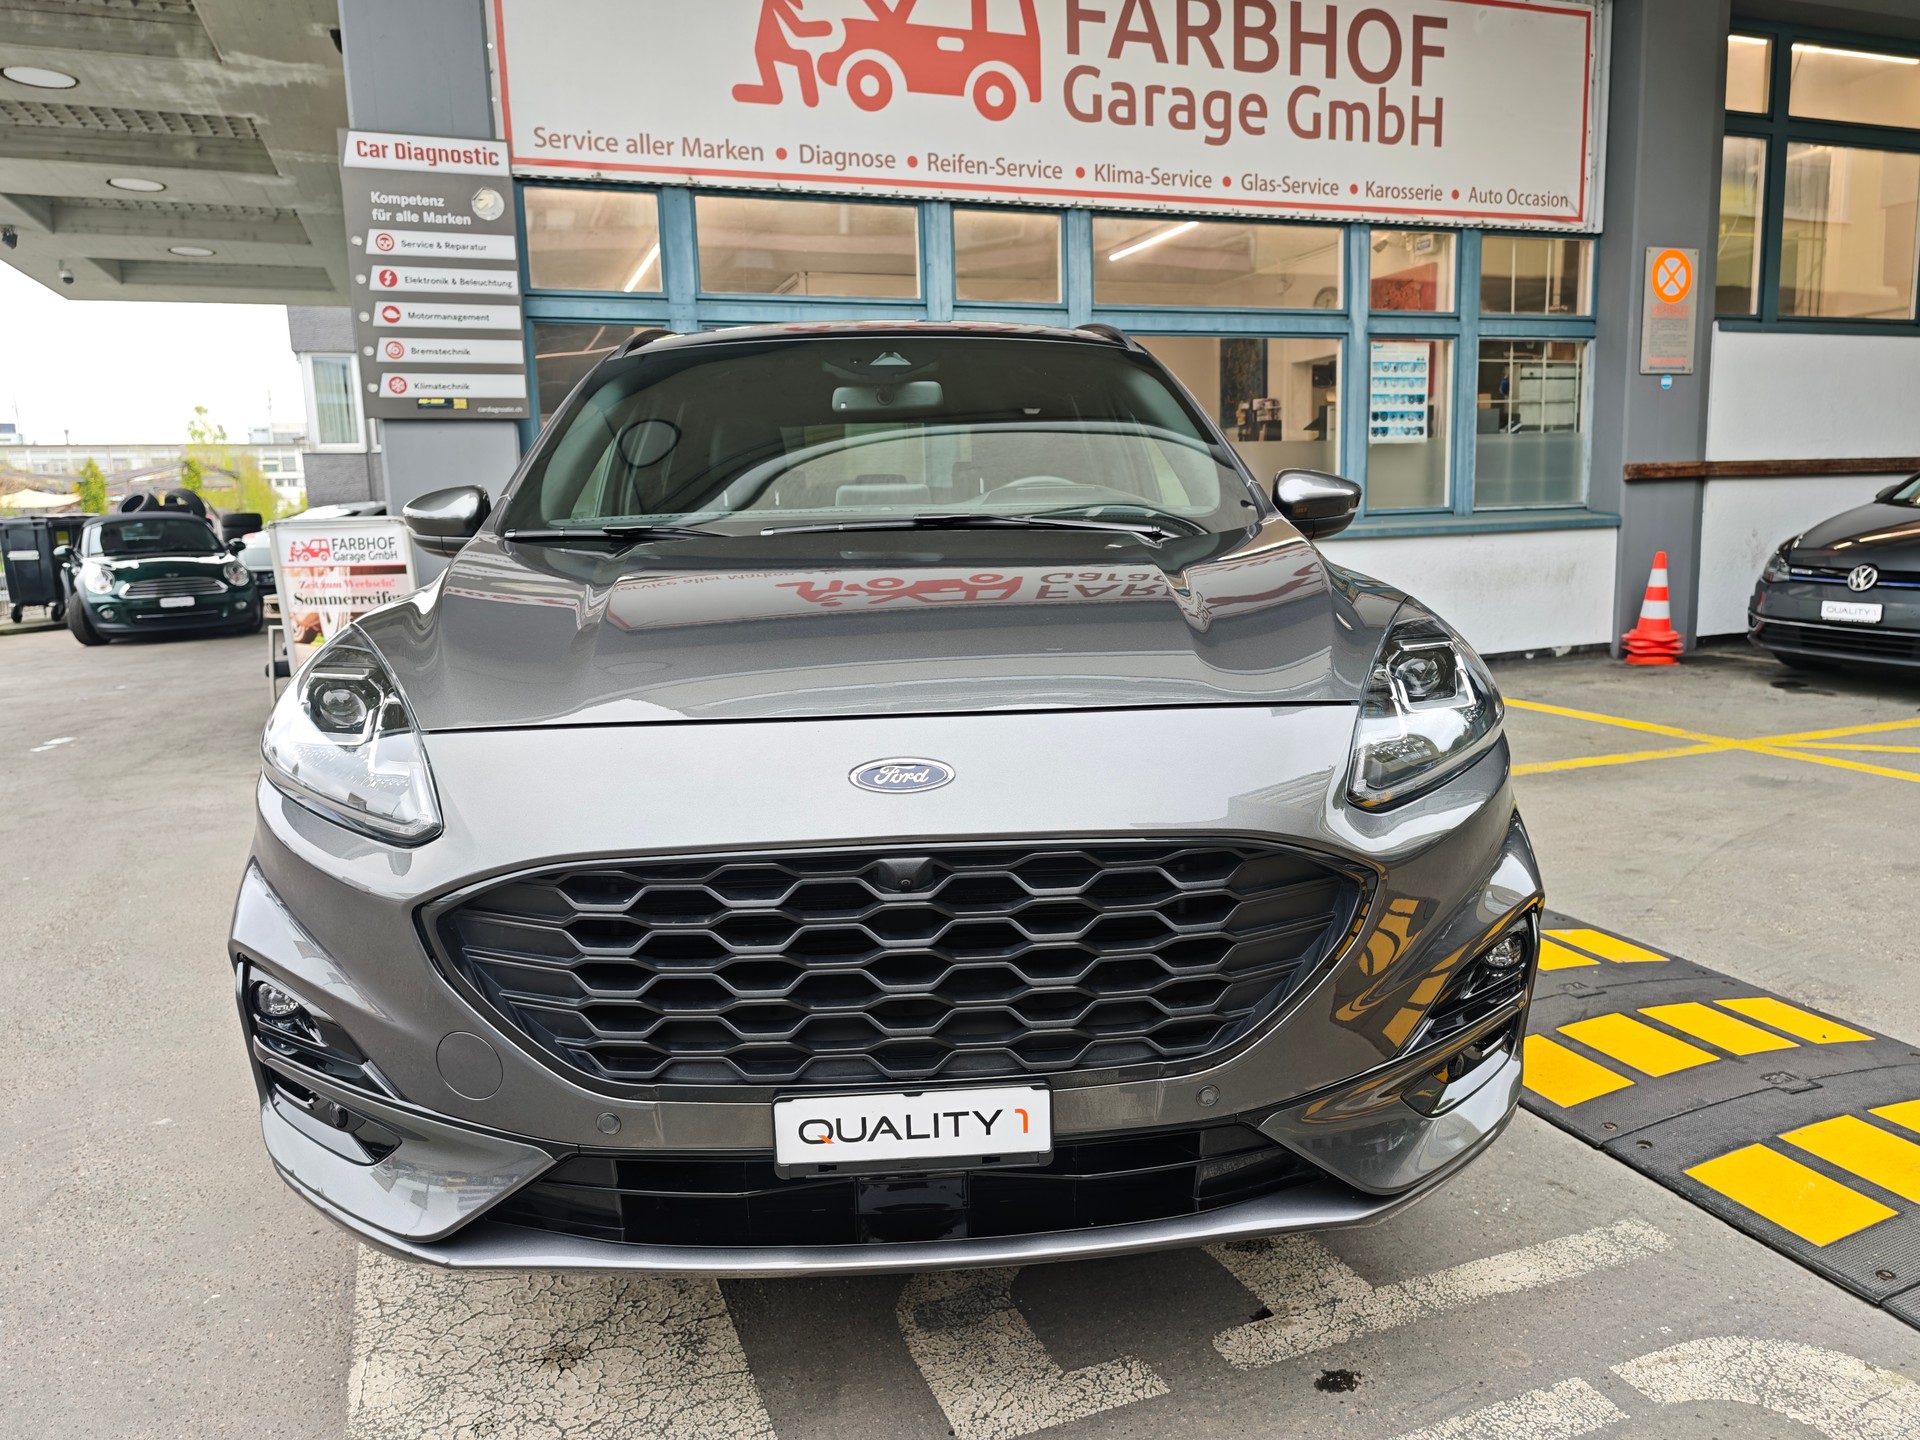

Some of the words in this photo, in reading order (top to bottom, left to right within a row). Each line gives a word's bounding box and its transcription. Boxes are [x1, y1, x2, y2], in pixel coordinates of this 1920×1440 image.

[1065, 0, 1449, 87] FARBHOF
[1063, 64, 1268, 146] Garage
[1287, 84, 1444, 148] GmbH
[356, 140, 389, 160] Car
[395, 141, 500, 167] Diagnostic
[533, 126, 619, 154] Service
[625, 132, 674, 156] aller
[681, 136, 764, 162] Marken
[799, 144, 896, 171] Diagnose
[926, 152, 1063, 180] Reifen-Service
[1094, 163, 1213, 189] Klima-Service
[1240, 173, 1340, 197] Glas-Service
[1365, 180, 1443, 203] Karosserie
[1468, 186, 1503, 206] Auto
[1506, 188, 1569, 209] Occasion
[370, 190, 445, 209] Kompetenz
[372, 208, 392, 222] für
[396, 209, 420, 223] alle
[423, 212, 472, 226] Marken
[401, 239, 434, 250] Service
[436, 241, 442, 249] &
[444, 241, 487, 252] Reparatur
[404, 275, 450, 286] Elektronik
[460, 278, 513, 289] Beleuchtung
[407, 311, 490, 323] Motormanagement
[411, 347, 471, 357] Bremstechnik
[414, 382, 470, 391] Klimatechnik
[331, 536, 396, 551] FARBHOF
[333, 551, 366, 564] Garage
[368, 550, 398, 560] GmbH
[294, 591, 401, 606] Sommerreife
[1826, 606, 1871, 616] QUALITY
[873, 764, 930, 785] Ford
[797, 1108, 1004, 1145] QUALITY
[1014, 1107, 1029, 1134] 1
